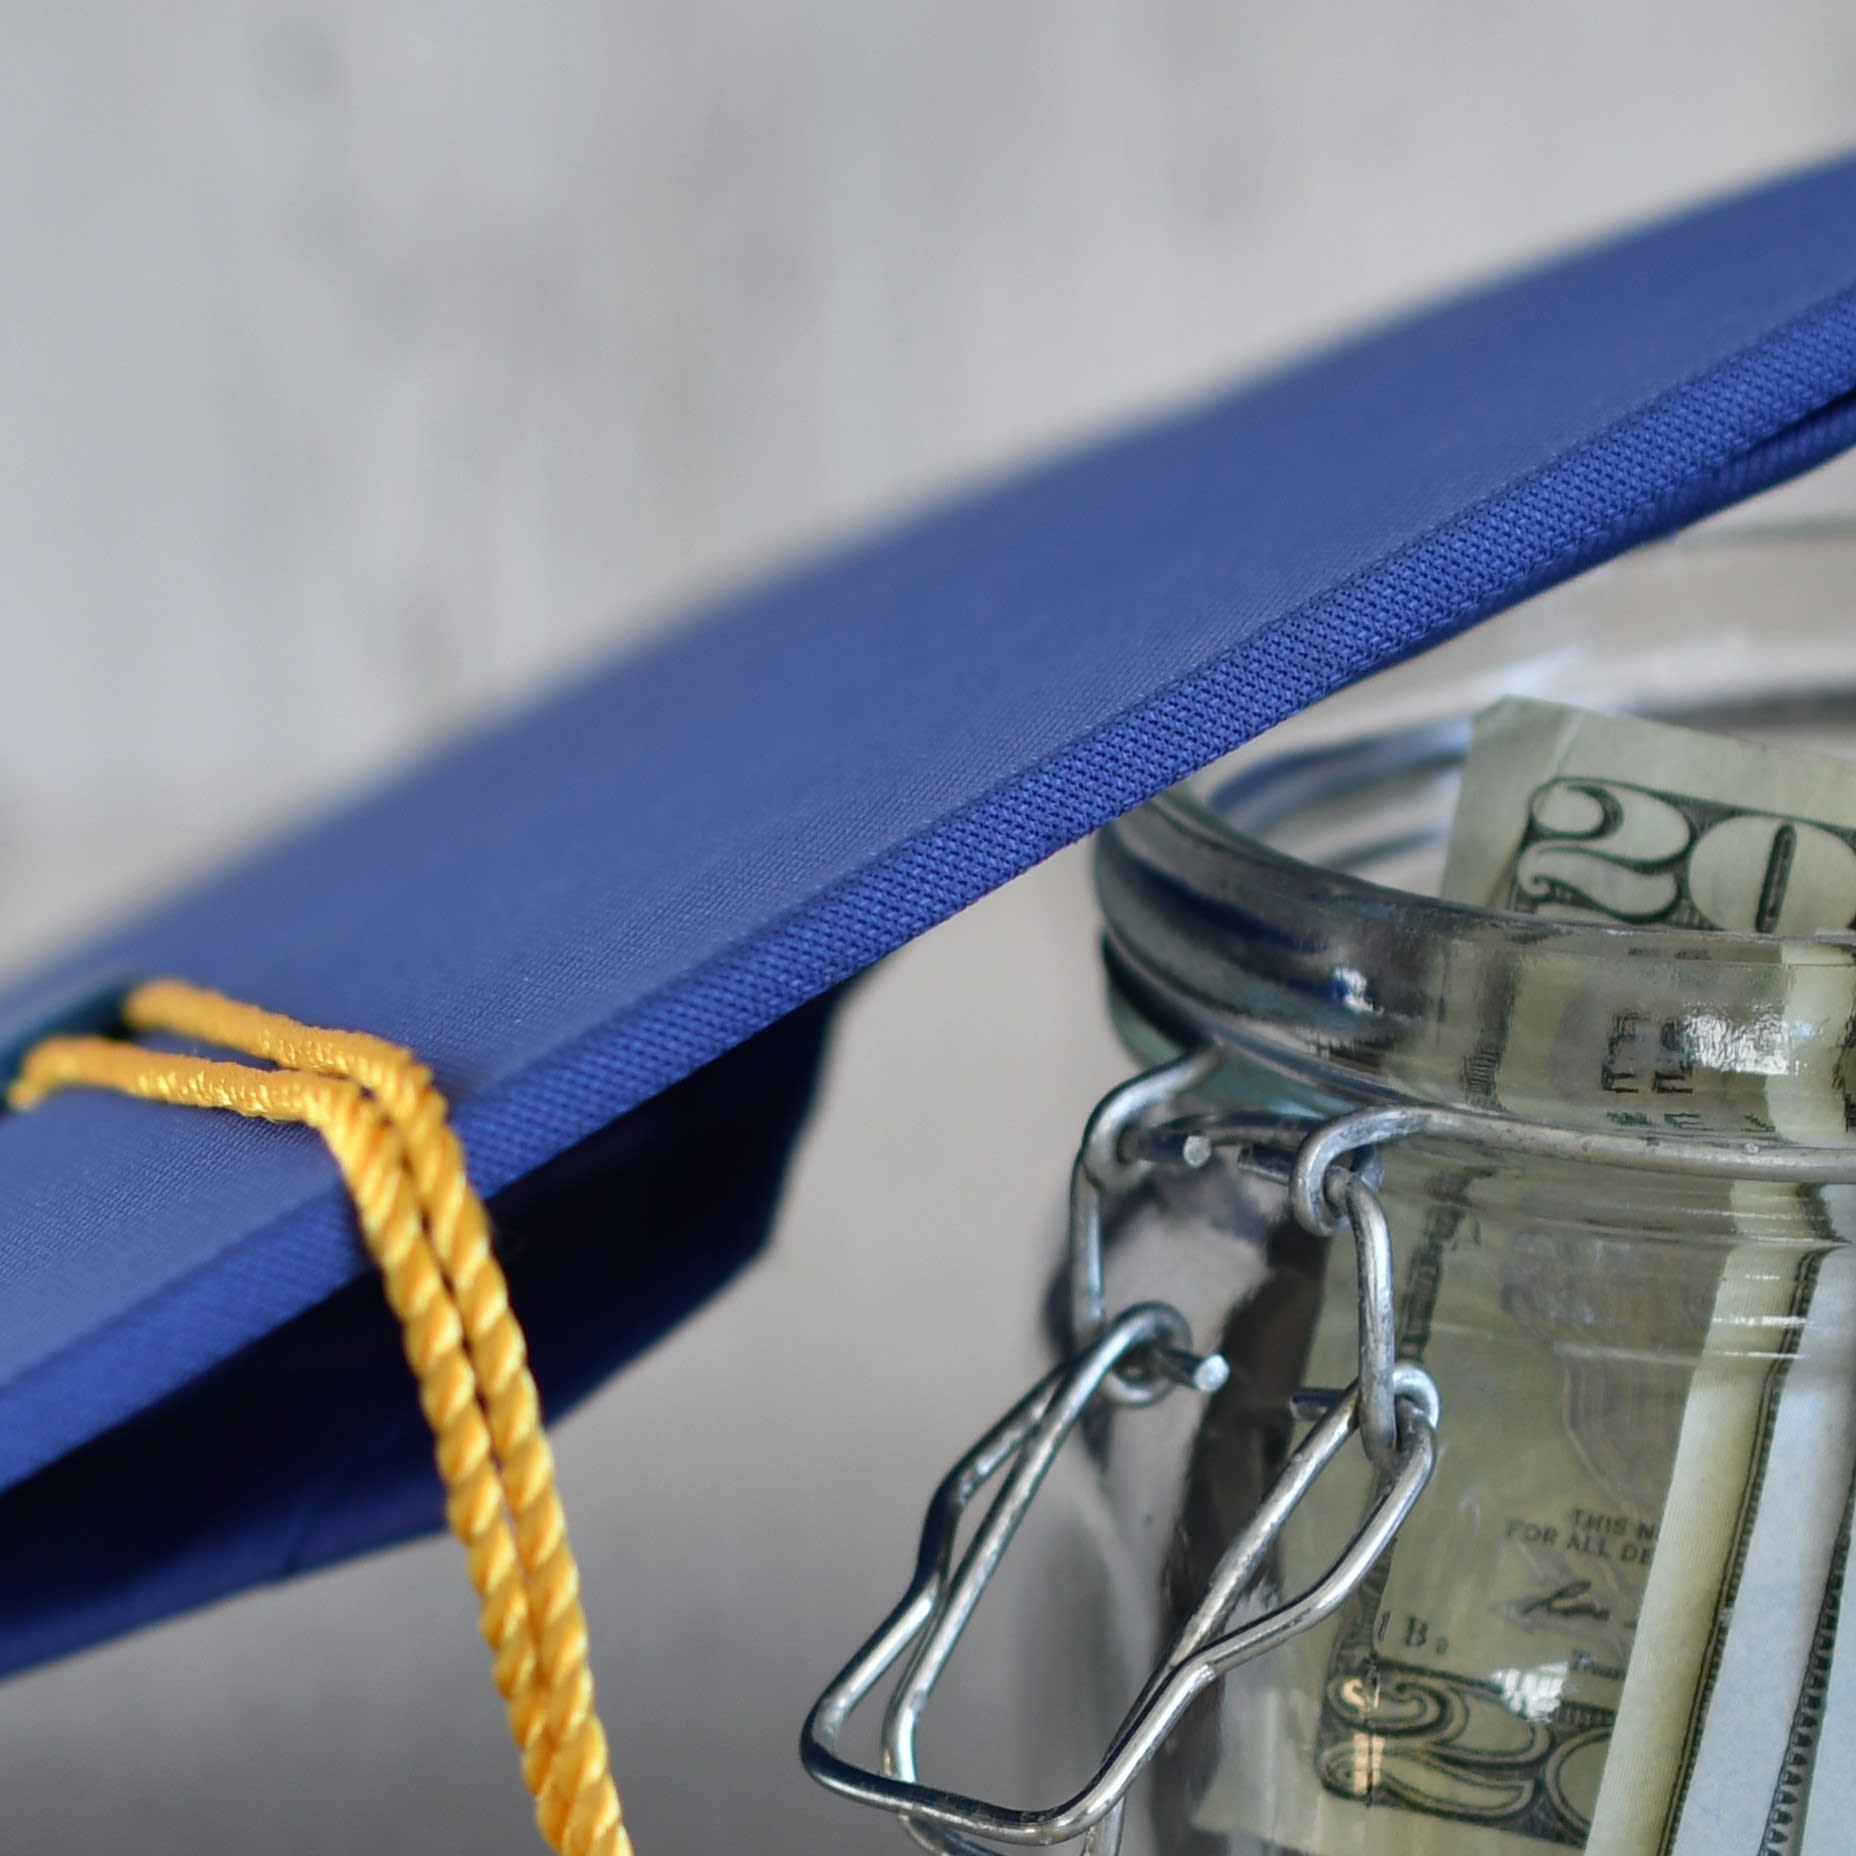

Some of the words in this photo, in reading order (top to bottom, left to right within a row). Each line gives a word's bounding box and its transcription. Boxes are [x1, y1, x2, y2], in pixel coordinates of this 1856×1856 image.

[1505, 1518, 1558, 1546] FOR
[1566, 1533, 1611, 1558] ALL
[1569, 1506, 1628, 1537] THIS
